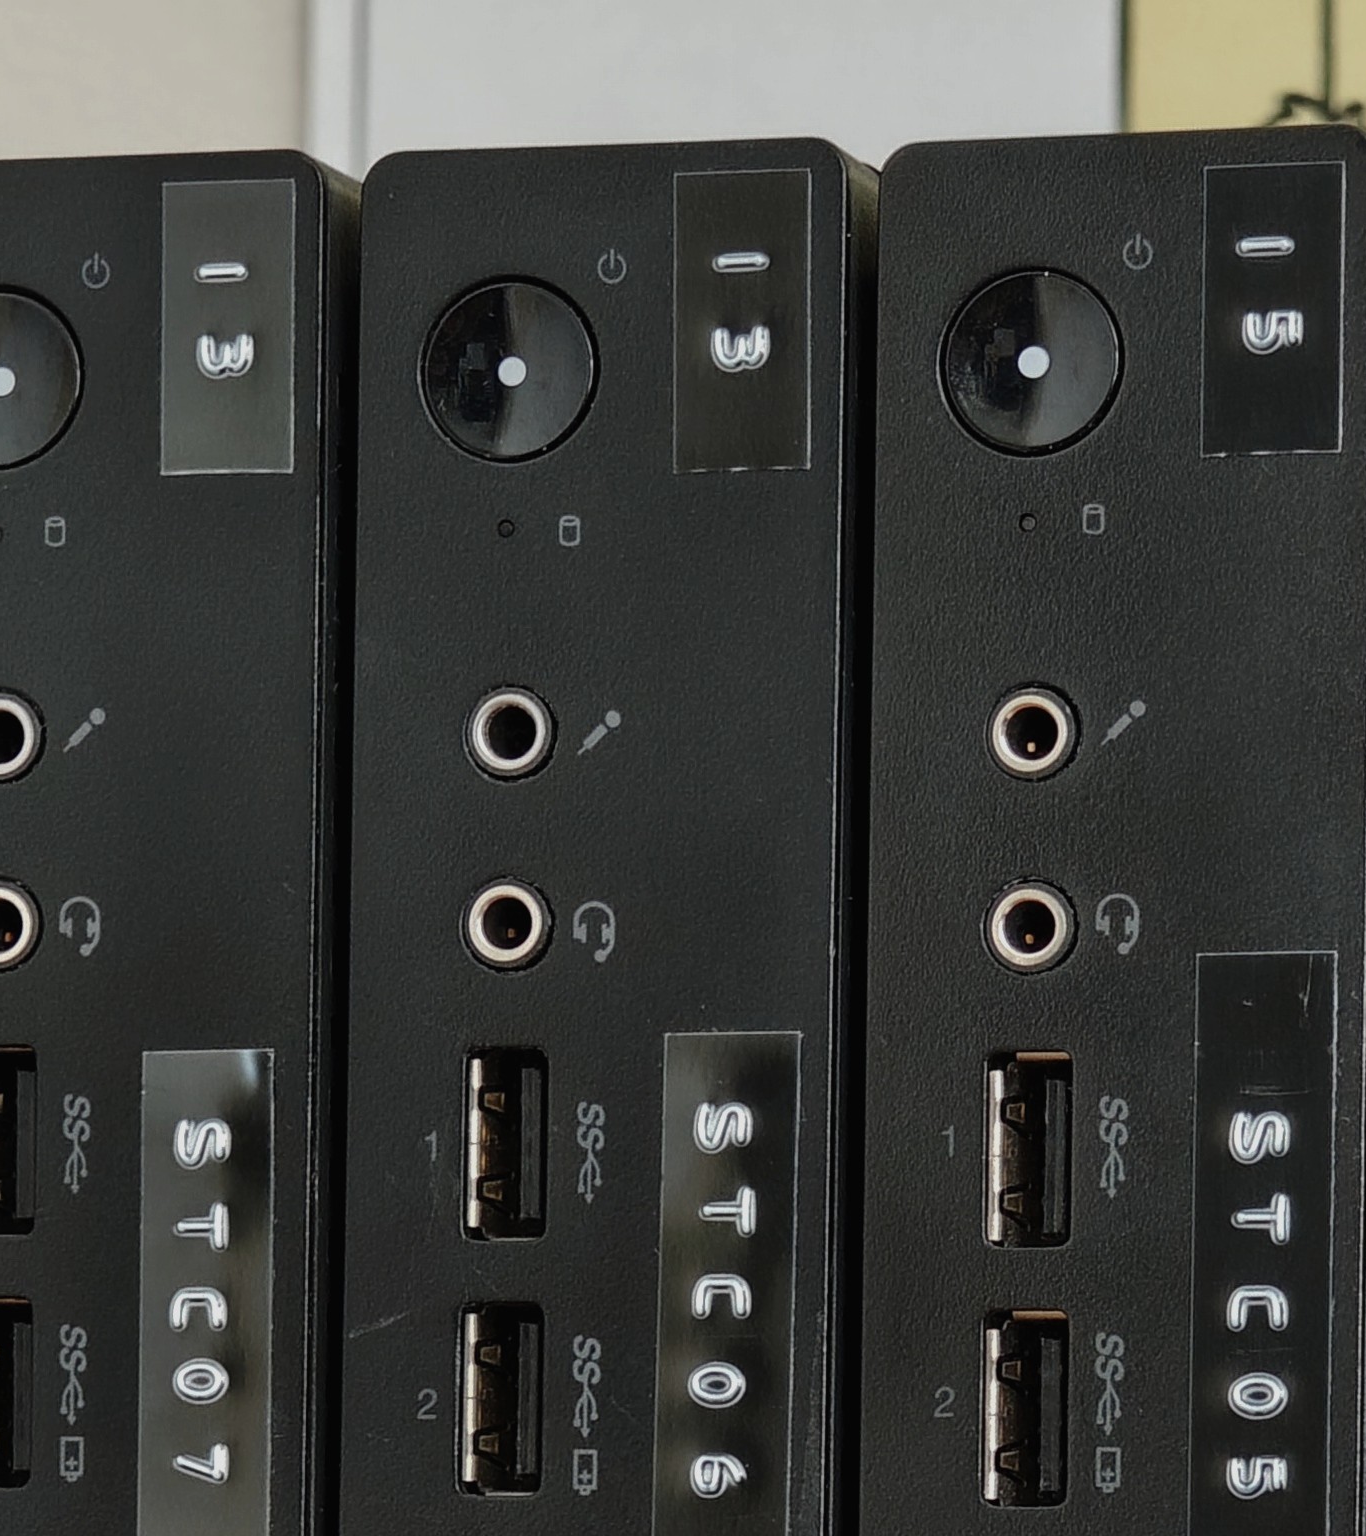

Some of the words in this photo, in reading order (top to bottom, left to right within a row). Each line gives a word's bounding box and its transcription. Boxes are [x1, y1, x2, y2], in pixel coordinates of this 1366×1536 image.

[425, 1132, 437, 1161] 1
[941, 1126, 956, 1156] 1
[168, 1117, 232, 1485] STC07
[687, 1101, 757, 1499] STC06
[1226, 1110, 1291, 1499] STC05
[418, 1388, 438, 1420] 2
[932, 1387, 956, 1418] 2
